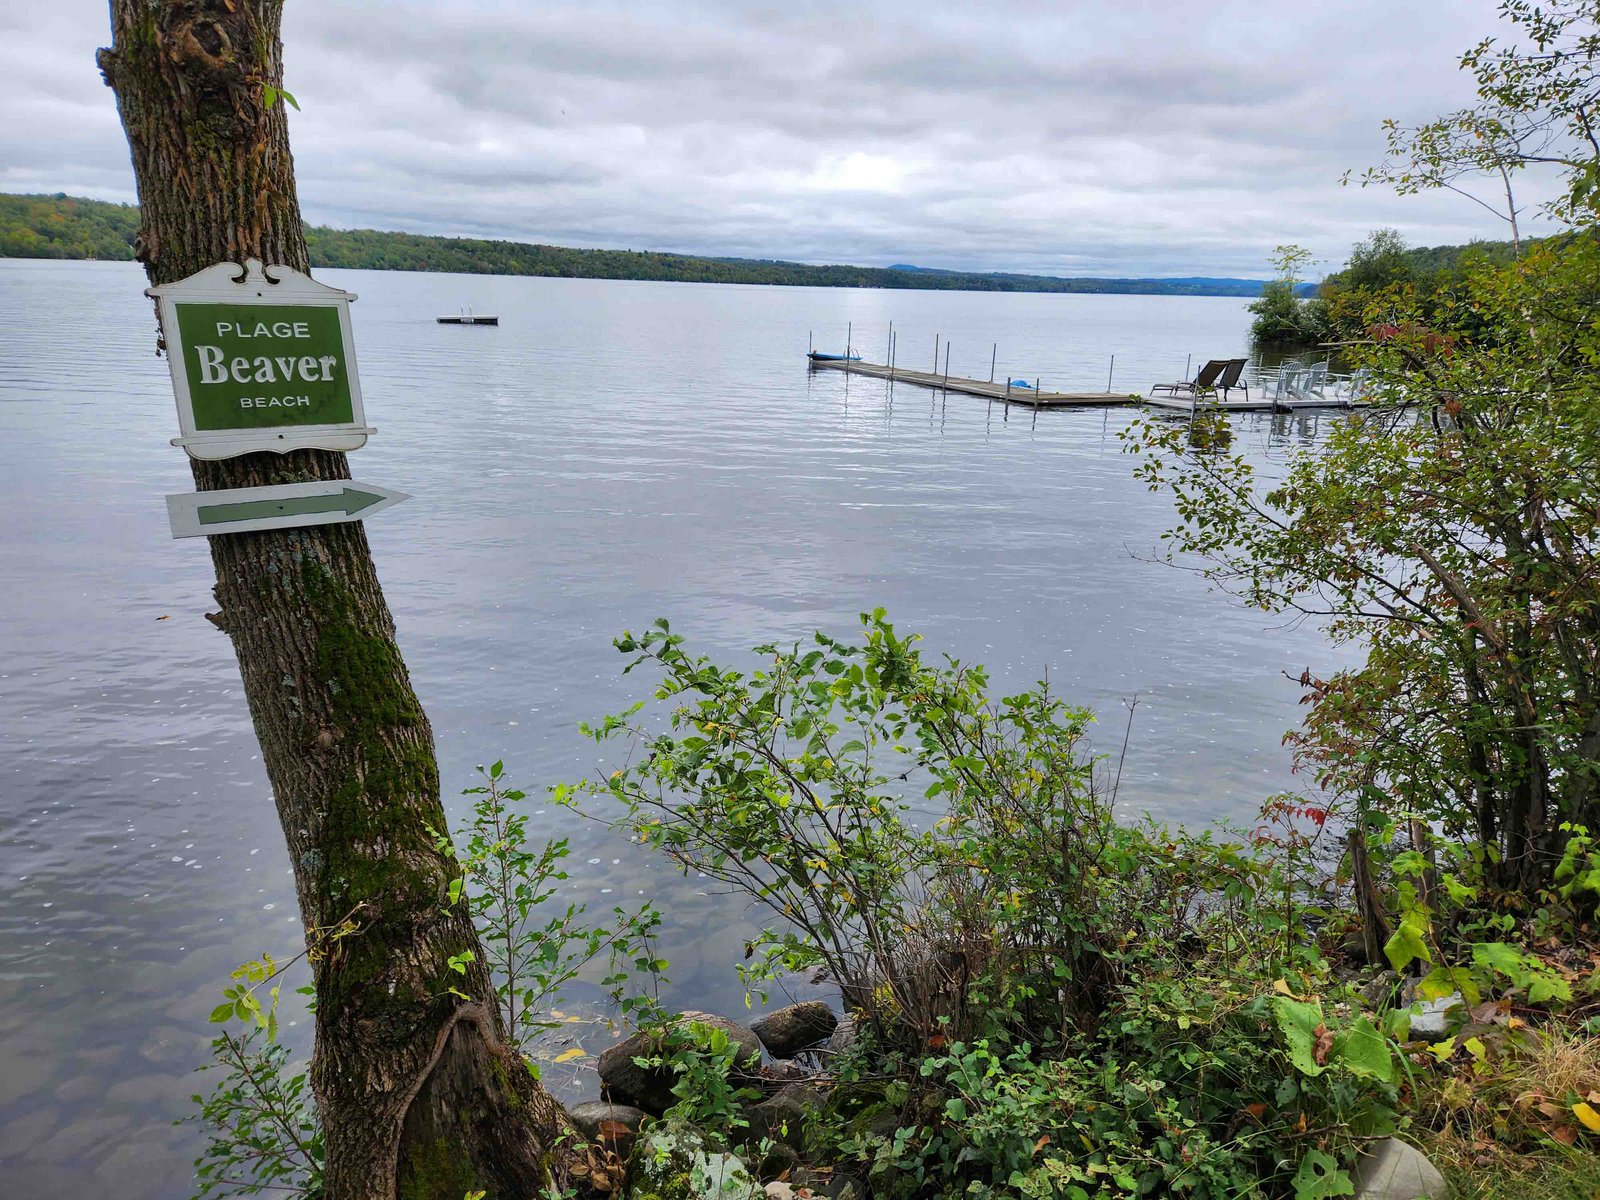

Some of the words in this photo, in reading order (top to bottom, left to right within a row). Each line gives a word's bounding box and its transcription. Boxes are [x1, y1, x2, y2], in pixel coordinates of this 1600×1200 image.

[216, 322, 310, 338] PLAGE
[194, 345, 337, 384] Beaver
[240, 396, 310, 408] BEACH
